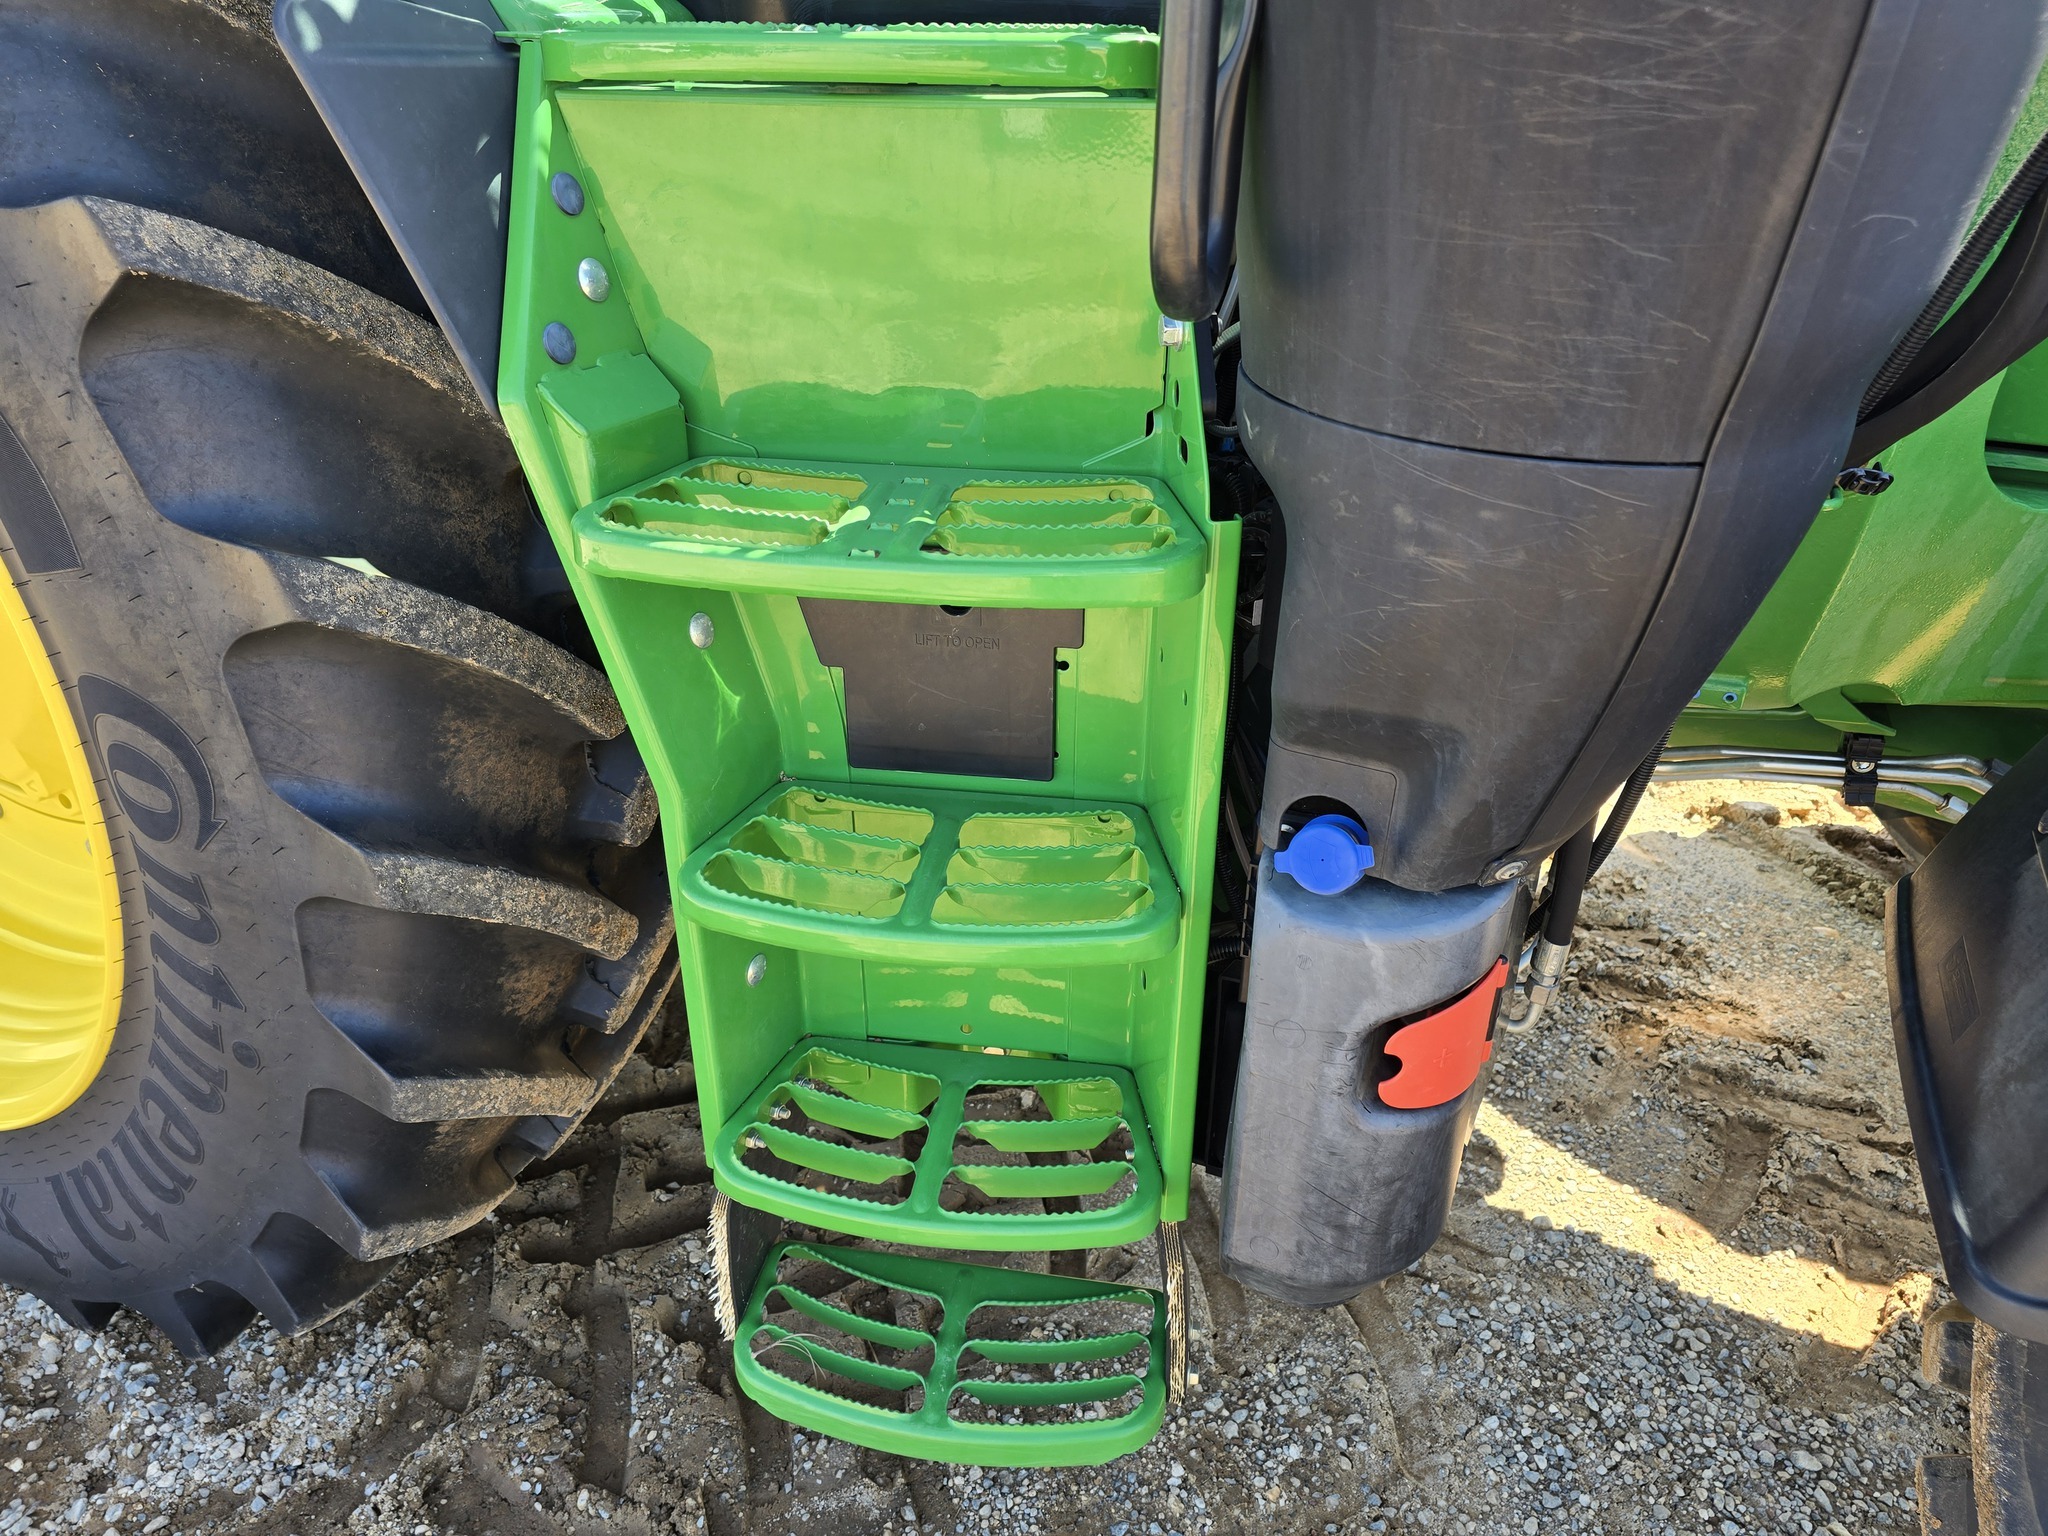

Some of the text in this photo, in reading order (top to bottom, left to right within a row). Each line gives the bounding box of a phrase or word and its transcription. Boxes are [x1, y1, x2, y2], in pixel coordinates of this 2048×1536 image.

[915, 633, 1000, 650] LIFT TO OPEN
[45, 673, 261, 1271] Continental
